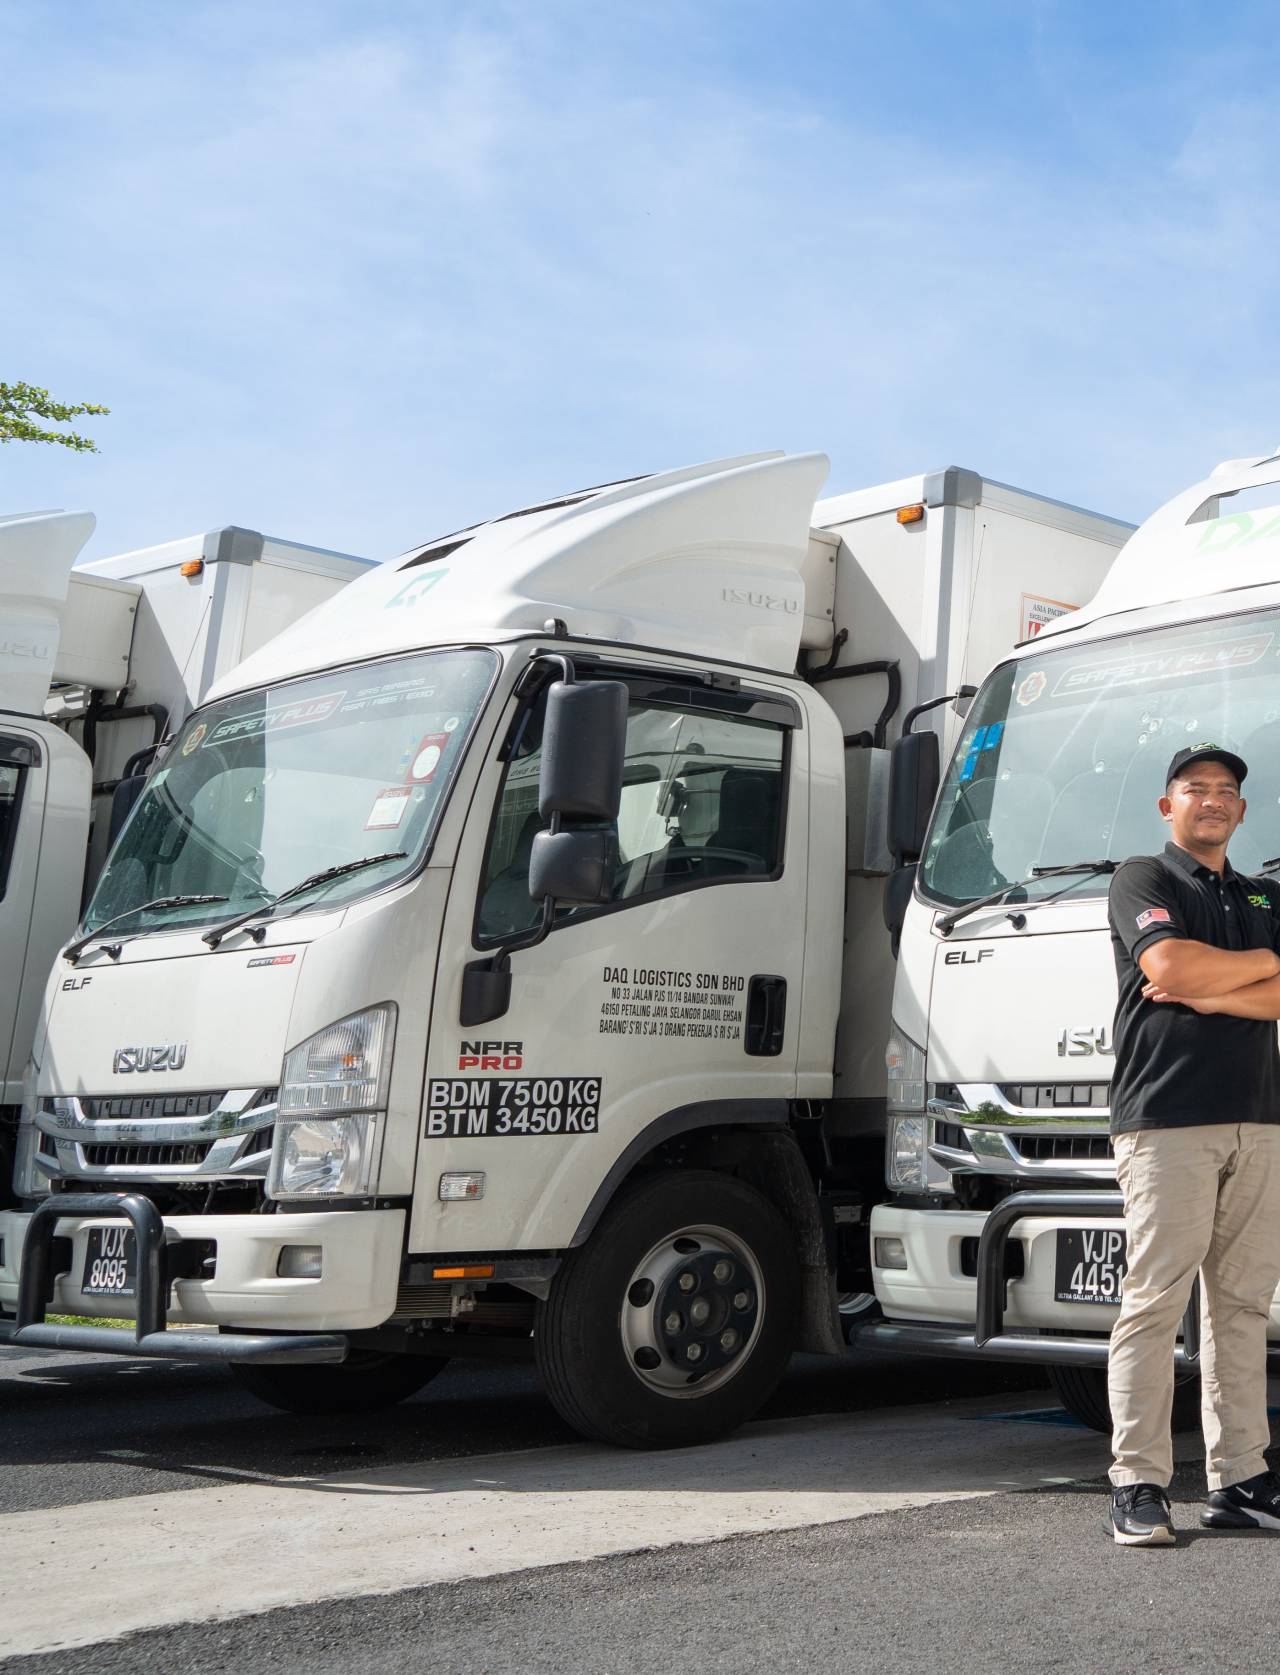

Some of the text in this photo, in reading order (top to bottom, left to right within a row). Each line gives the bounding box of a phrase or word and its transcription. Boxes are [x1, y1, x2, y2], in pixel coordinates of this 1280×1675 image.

[722, 588, 798, 615] ISUZU
[1065, 644, 1257, 687] SAFETY PLUS
[212, 700, 334, 739] SAFETY PLUS
[944, 949, 995, 965] ELF
[62, 976, 92, 991] ELF
[603, 967, 744, 992] DAQ LOGISTICS SDN BHD
[611, 987, 735, 1006] NO 33 JALAN PJS 11/14 BANDAR SUNWAY
[600, 1002, 742, 1023] 46150 PETALING JAYA SELANGOR DARUL EHSAN
[658, 1022, 664, 1036] 3
[664, 1022, 686, 1037] ORANG
[686, 1023, 713, 1038] PEKERJA
[1057, 1026, 1116, 1056] ISU
[112, 1043, 188, 1074] ISUZU
[460, 1041, 523, 1055] NPR
[458, 1056, 523, 1071] PRO
[430, 1080, 599, 1107] BDM 7500 KG
[427, 1106, 596, 1136] BTM 3450 KG
[101, 1228, 128, 1257] VJX
[1082, 1230, 1122, 1263] VJP
[90, 1259, 128, 1288] 8095
[1070, 1262, 1123, 1296] 4451
